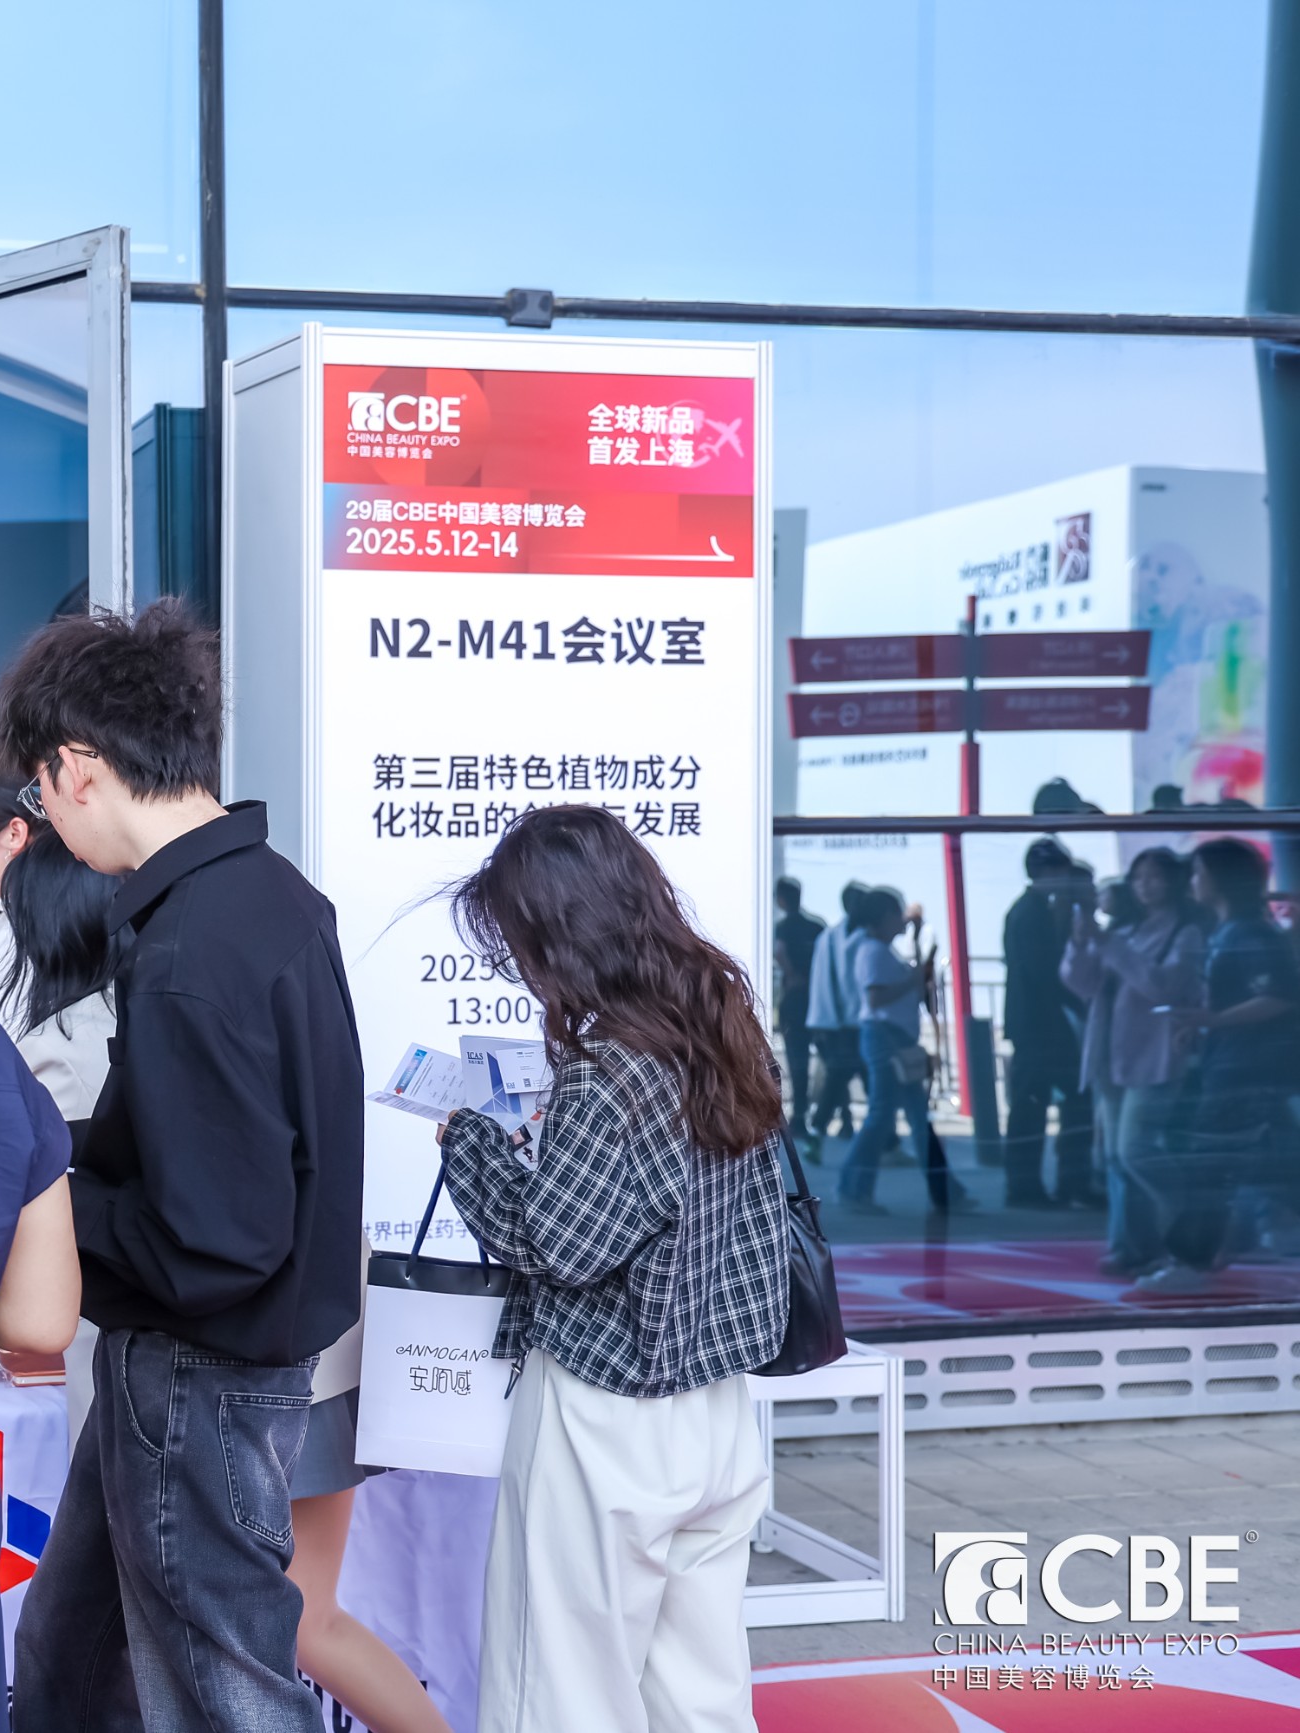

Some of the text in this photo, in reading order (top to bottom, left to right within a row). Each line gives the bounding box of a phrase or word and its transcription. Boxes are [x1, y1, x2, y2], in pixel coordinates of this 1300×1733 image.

[386, 395, 461, 432] CBE
[588, 404, 694, 434] 全球新品
[347, 432, 460, 447] CHINA BEAUTY EXPO
[347, 446, 433, 460] 中国美容博览会
[588, 437, 694, 466] 首发上海
[346, 500, 586, 528] 29届CBE中国美容博览会
[346, 527, 518, 558] 2025.5.12-14
[370, 616, 706, 666] N2-M41会议室
[373, 753, 702, 791] 第三届特色植物成分
[396, 1344, 488, 1363] ANMOGAN
